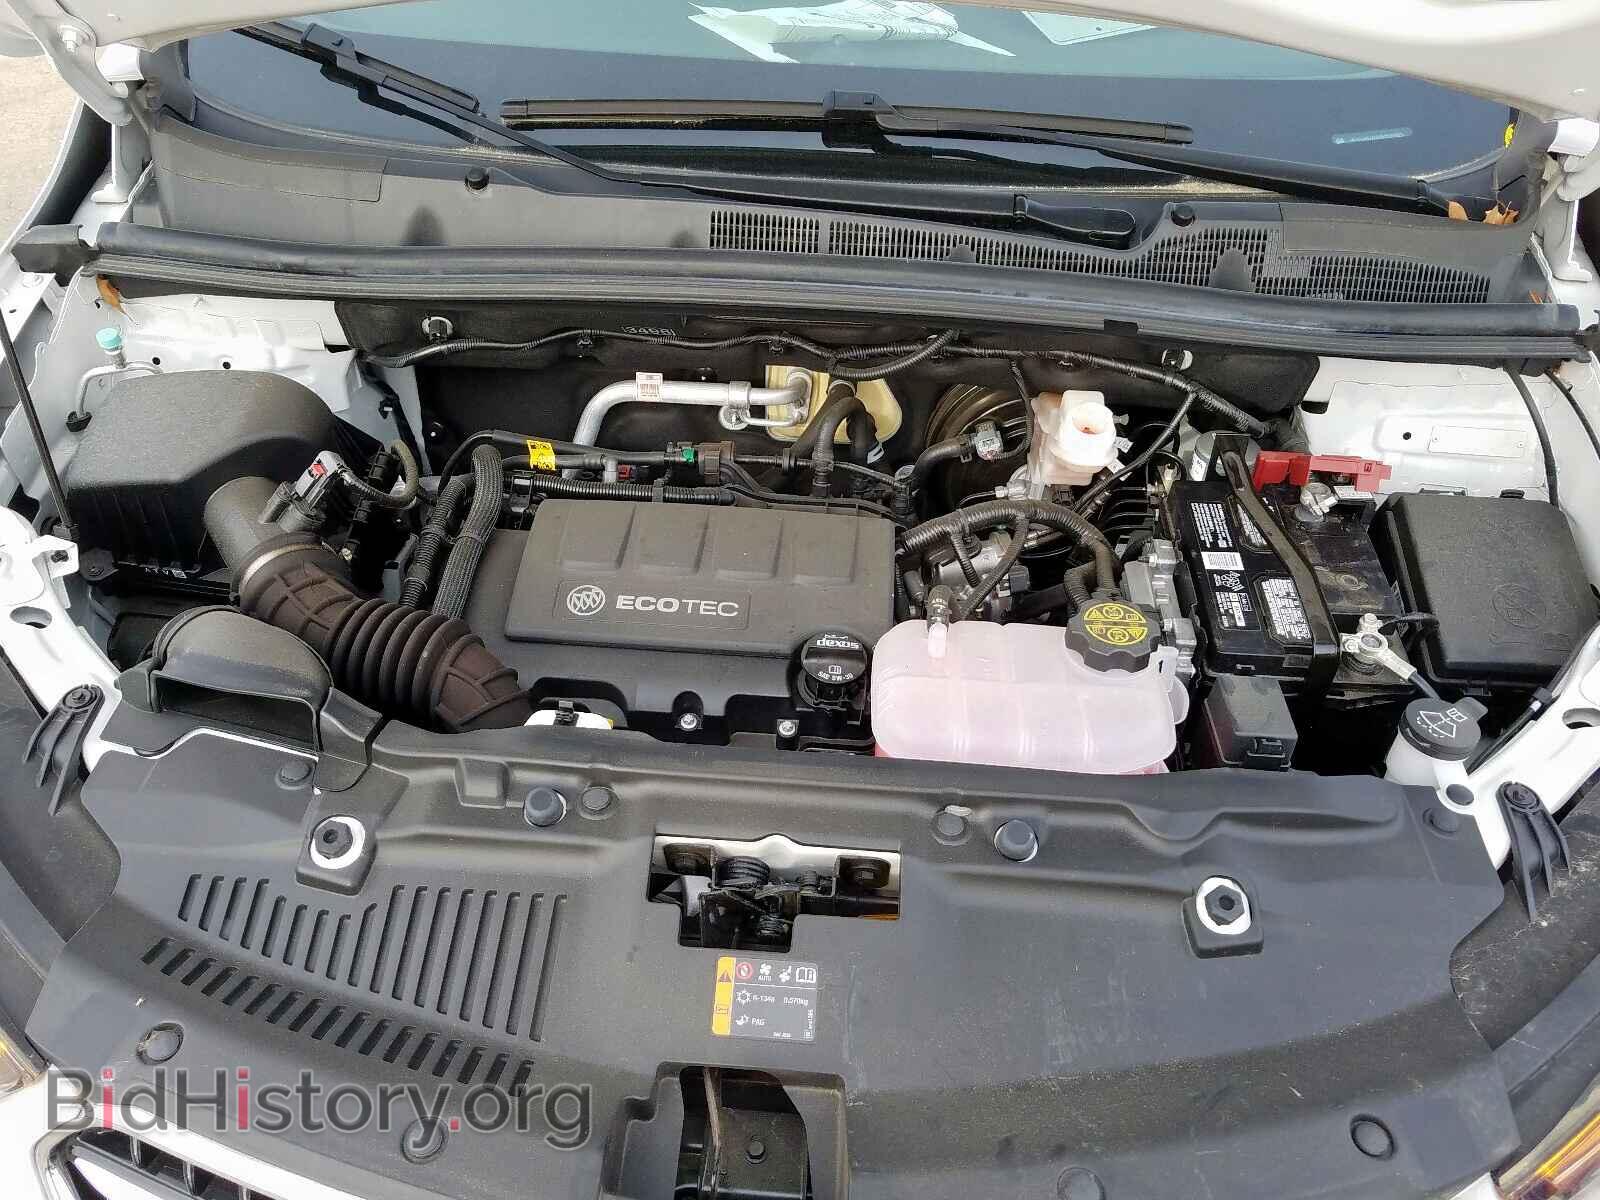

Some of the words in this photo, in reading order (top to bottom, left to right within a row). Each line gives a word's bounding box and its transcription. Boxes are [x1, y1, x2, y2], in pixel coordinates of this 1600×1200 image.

[615, 594, 739, 617] ECOTEC
[817, 637, 860, 649] dexos
[751, 1018, 766, 1026] PAG
